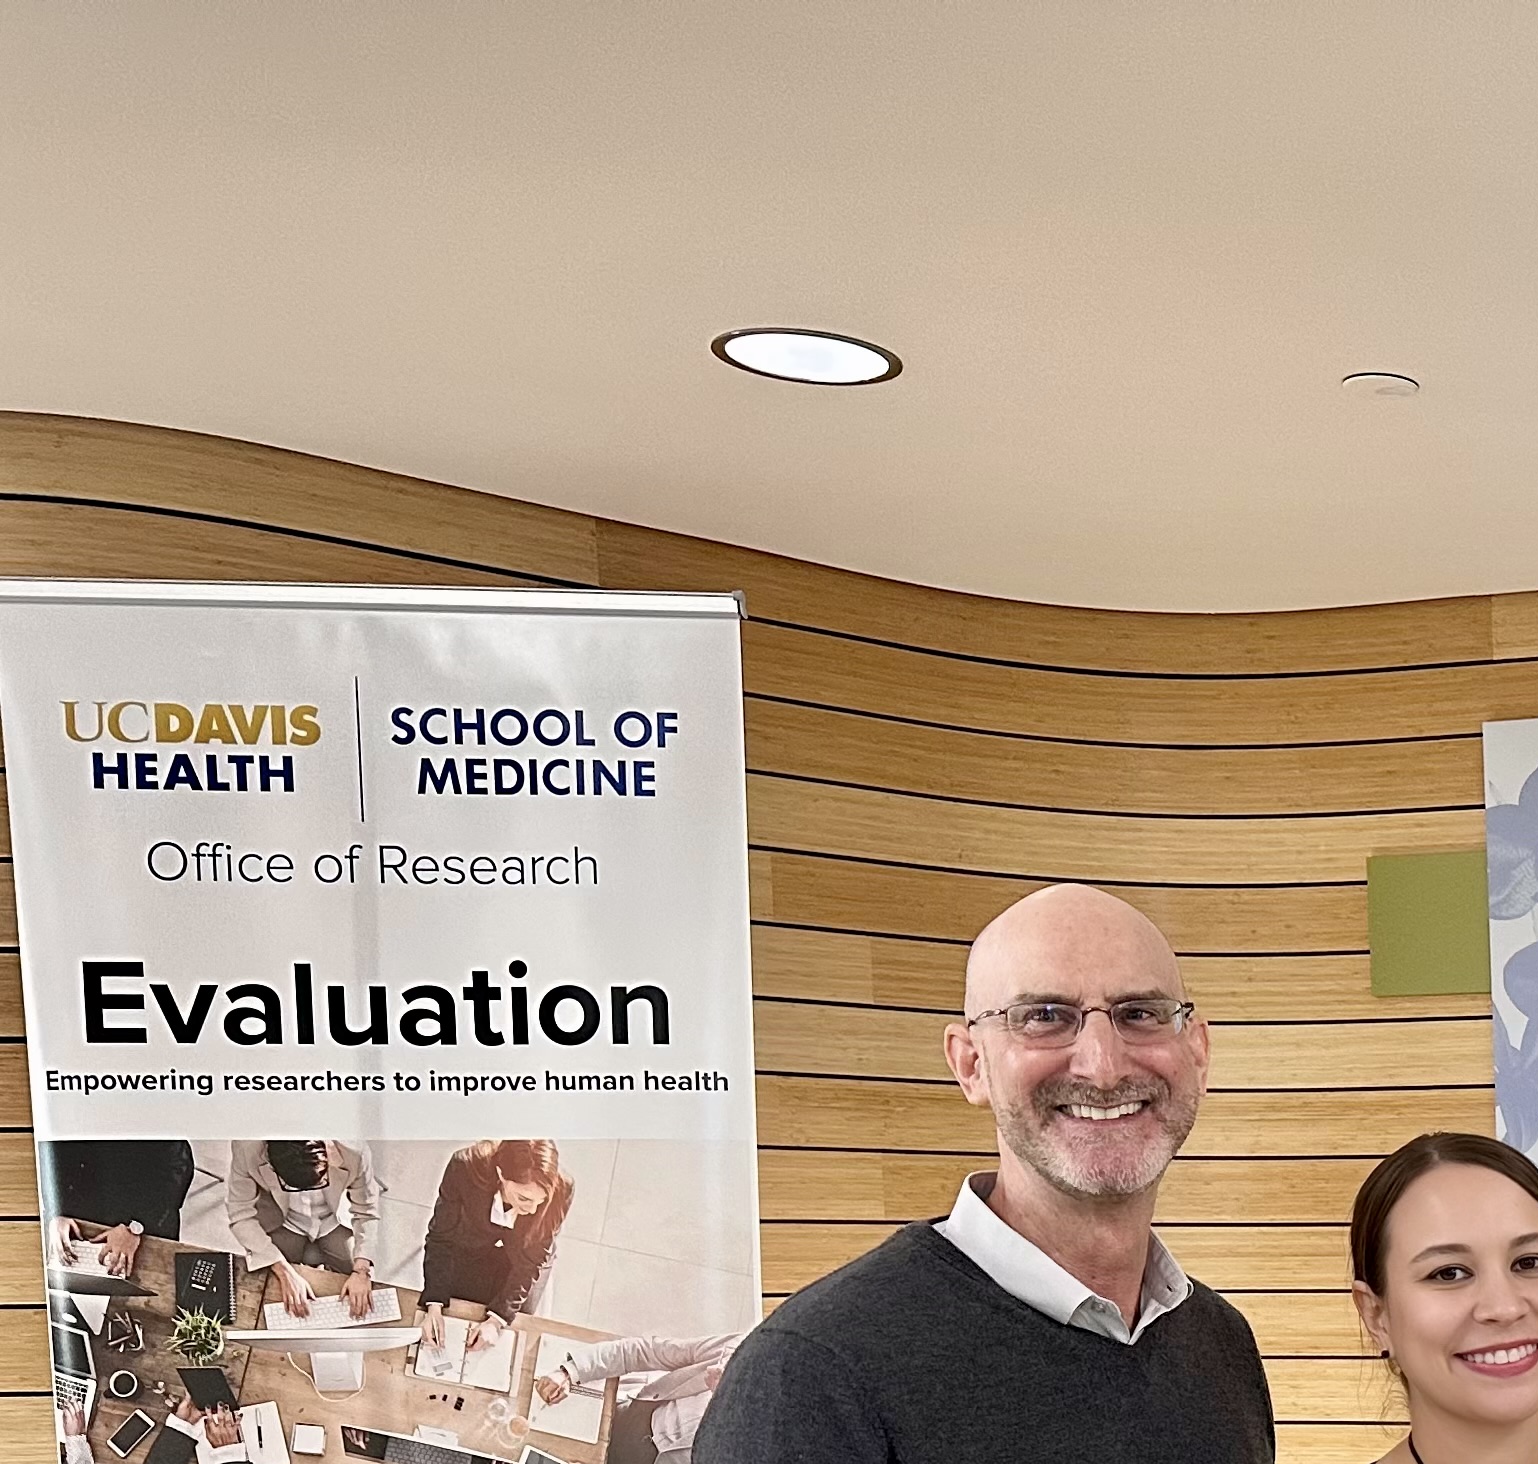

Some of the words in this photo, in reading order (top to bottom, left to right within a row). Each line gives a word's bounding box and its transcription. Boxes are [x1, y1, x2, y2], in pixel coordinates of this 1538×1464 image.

[391, 706, 596, 747] SCHOOL
[613, 710, 678, 749] OF
[91, 752, 295, 793] HEALTH
[417, 757, 656, 797] MEDICINE
[147, 841, 294, 883] Office
[314, 844, 363, 884] of
[378, 845, 598, 885] Research
[81, 959, 670, 1047] Evaluation
[45, 1068, 214, 1096] Empowering
[223, 1070, 386, 1092] researchers
[392, 1072, 421, 1092] to
[429, 1069, 537, 1097] improve
[545, 1070, 635, 1091] human
[644, 1070, 729, 1092] health
